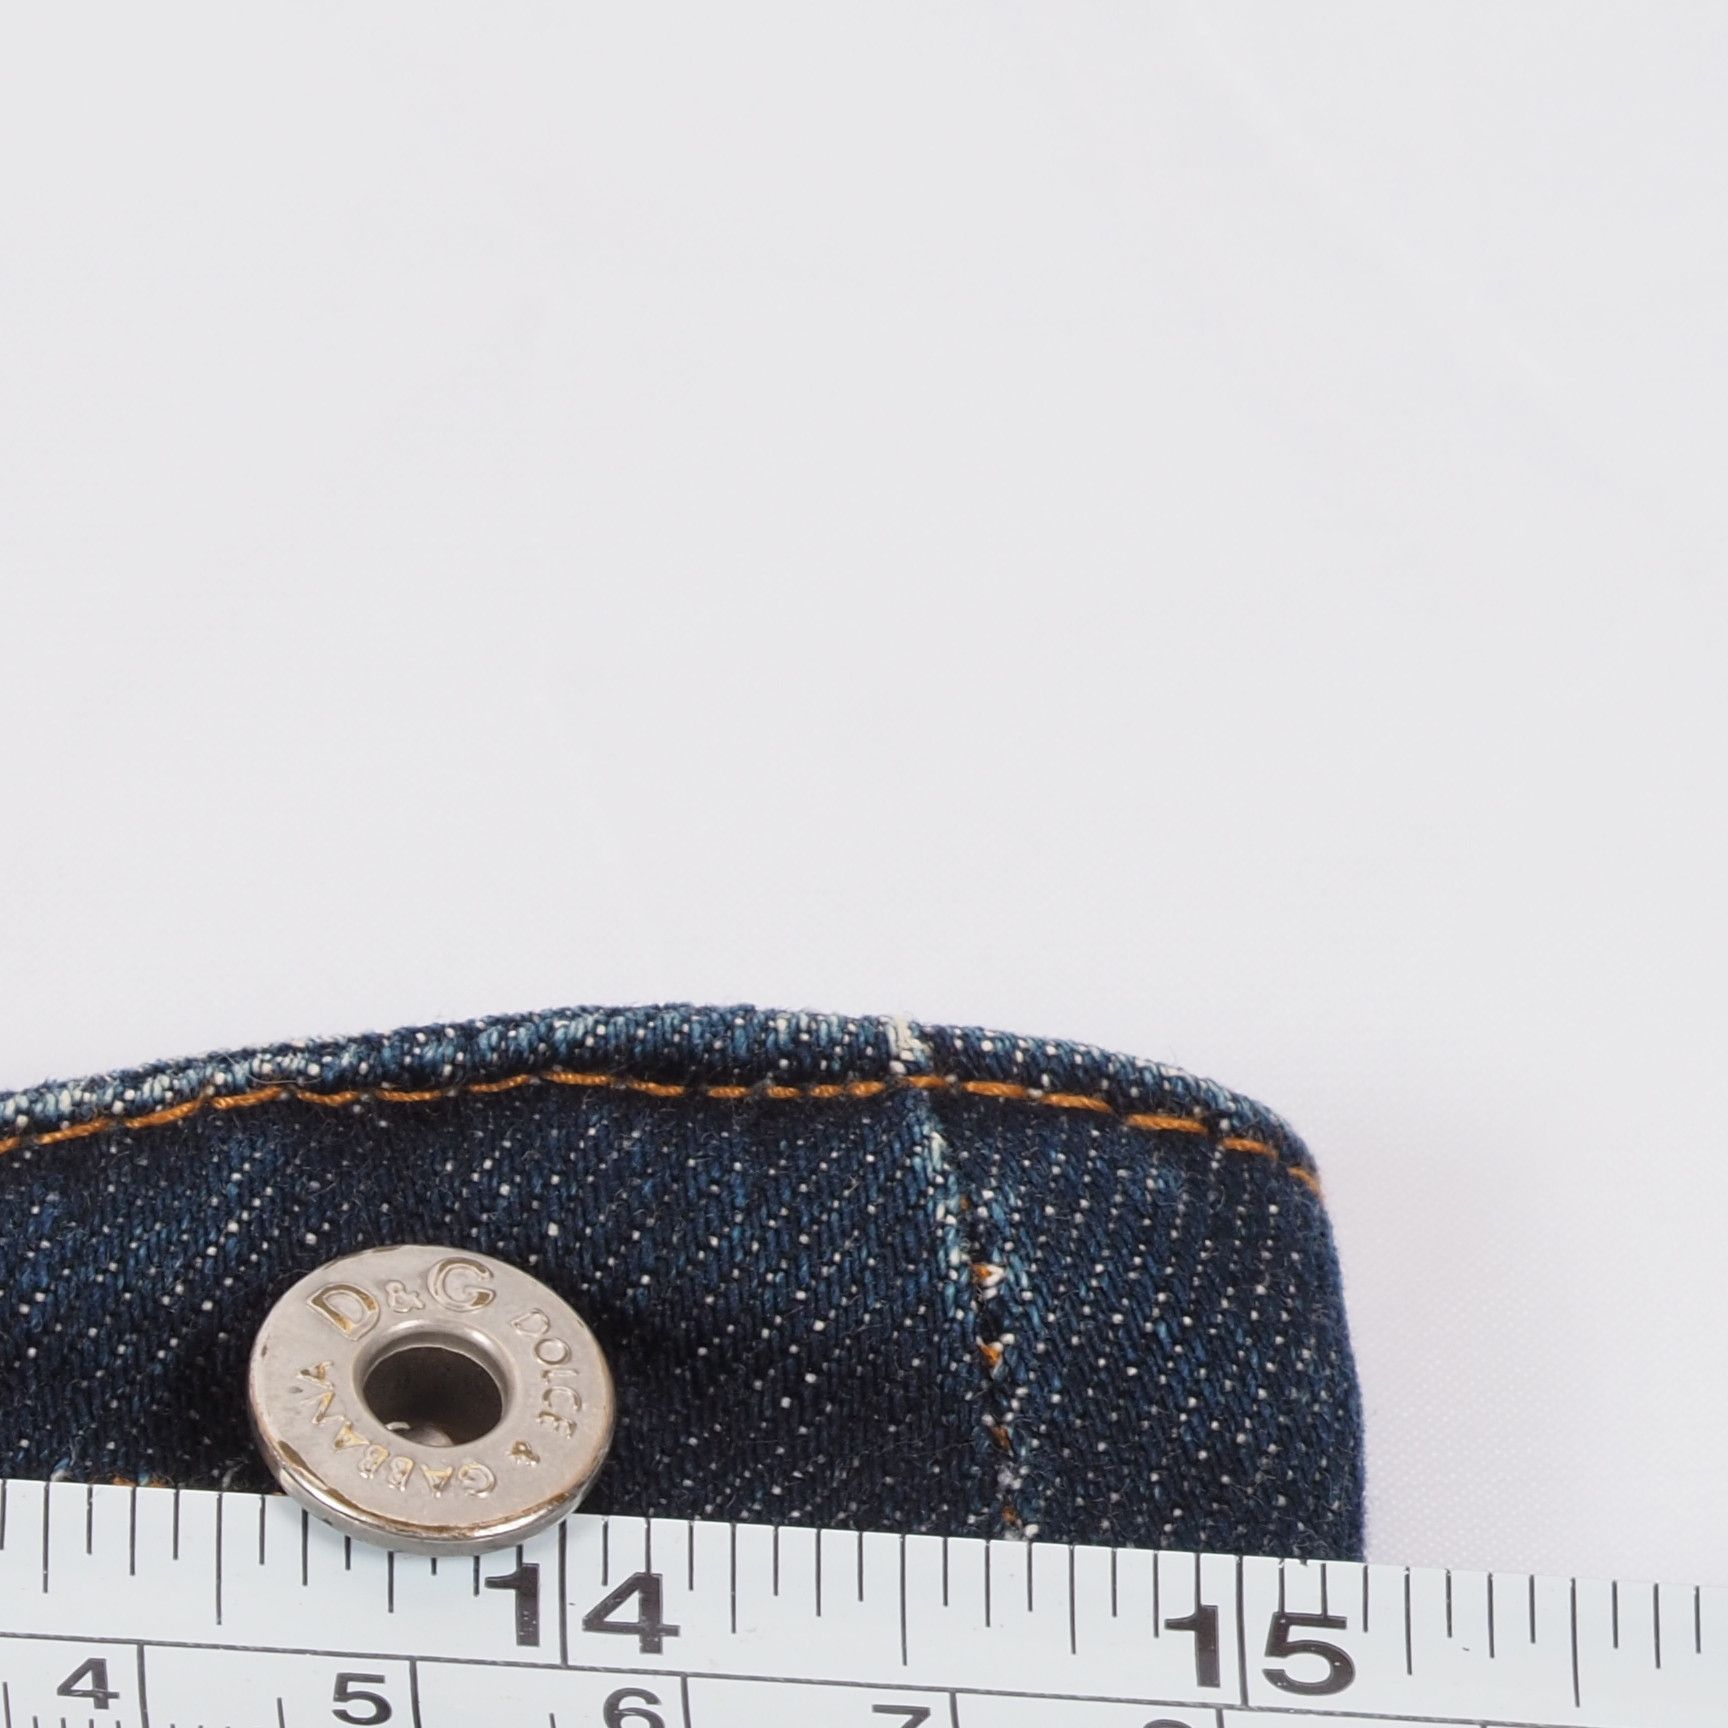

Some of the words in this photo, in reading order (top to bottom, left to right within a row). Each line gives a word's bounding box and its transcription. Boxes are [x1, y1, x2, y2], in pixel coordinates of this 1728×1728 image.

[305, 1256, 498, 1342] D&G
[509, 1308, 583, 1439] DOLCE
[289, 1360, 498, 1498] GABBANA
[484, 1561, 680, 1655] 14
[1164, 1603, 1357, 1697] 15
[55, 1657, 121, 1710] 4
[330, 1671, 394, 1727] 5
